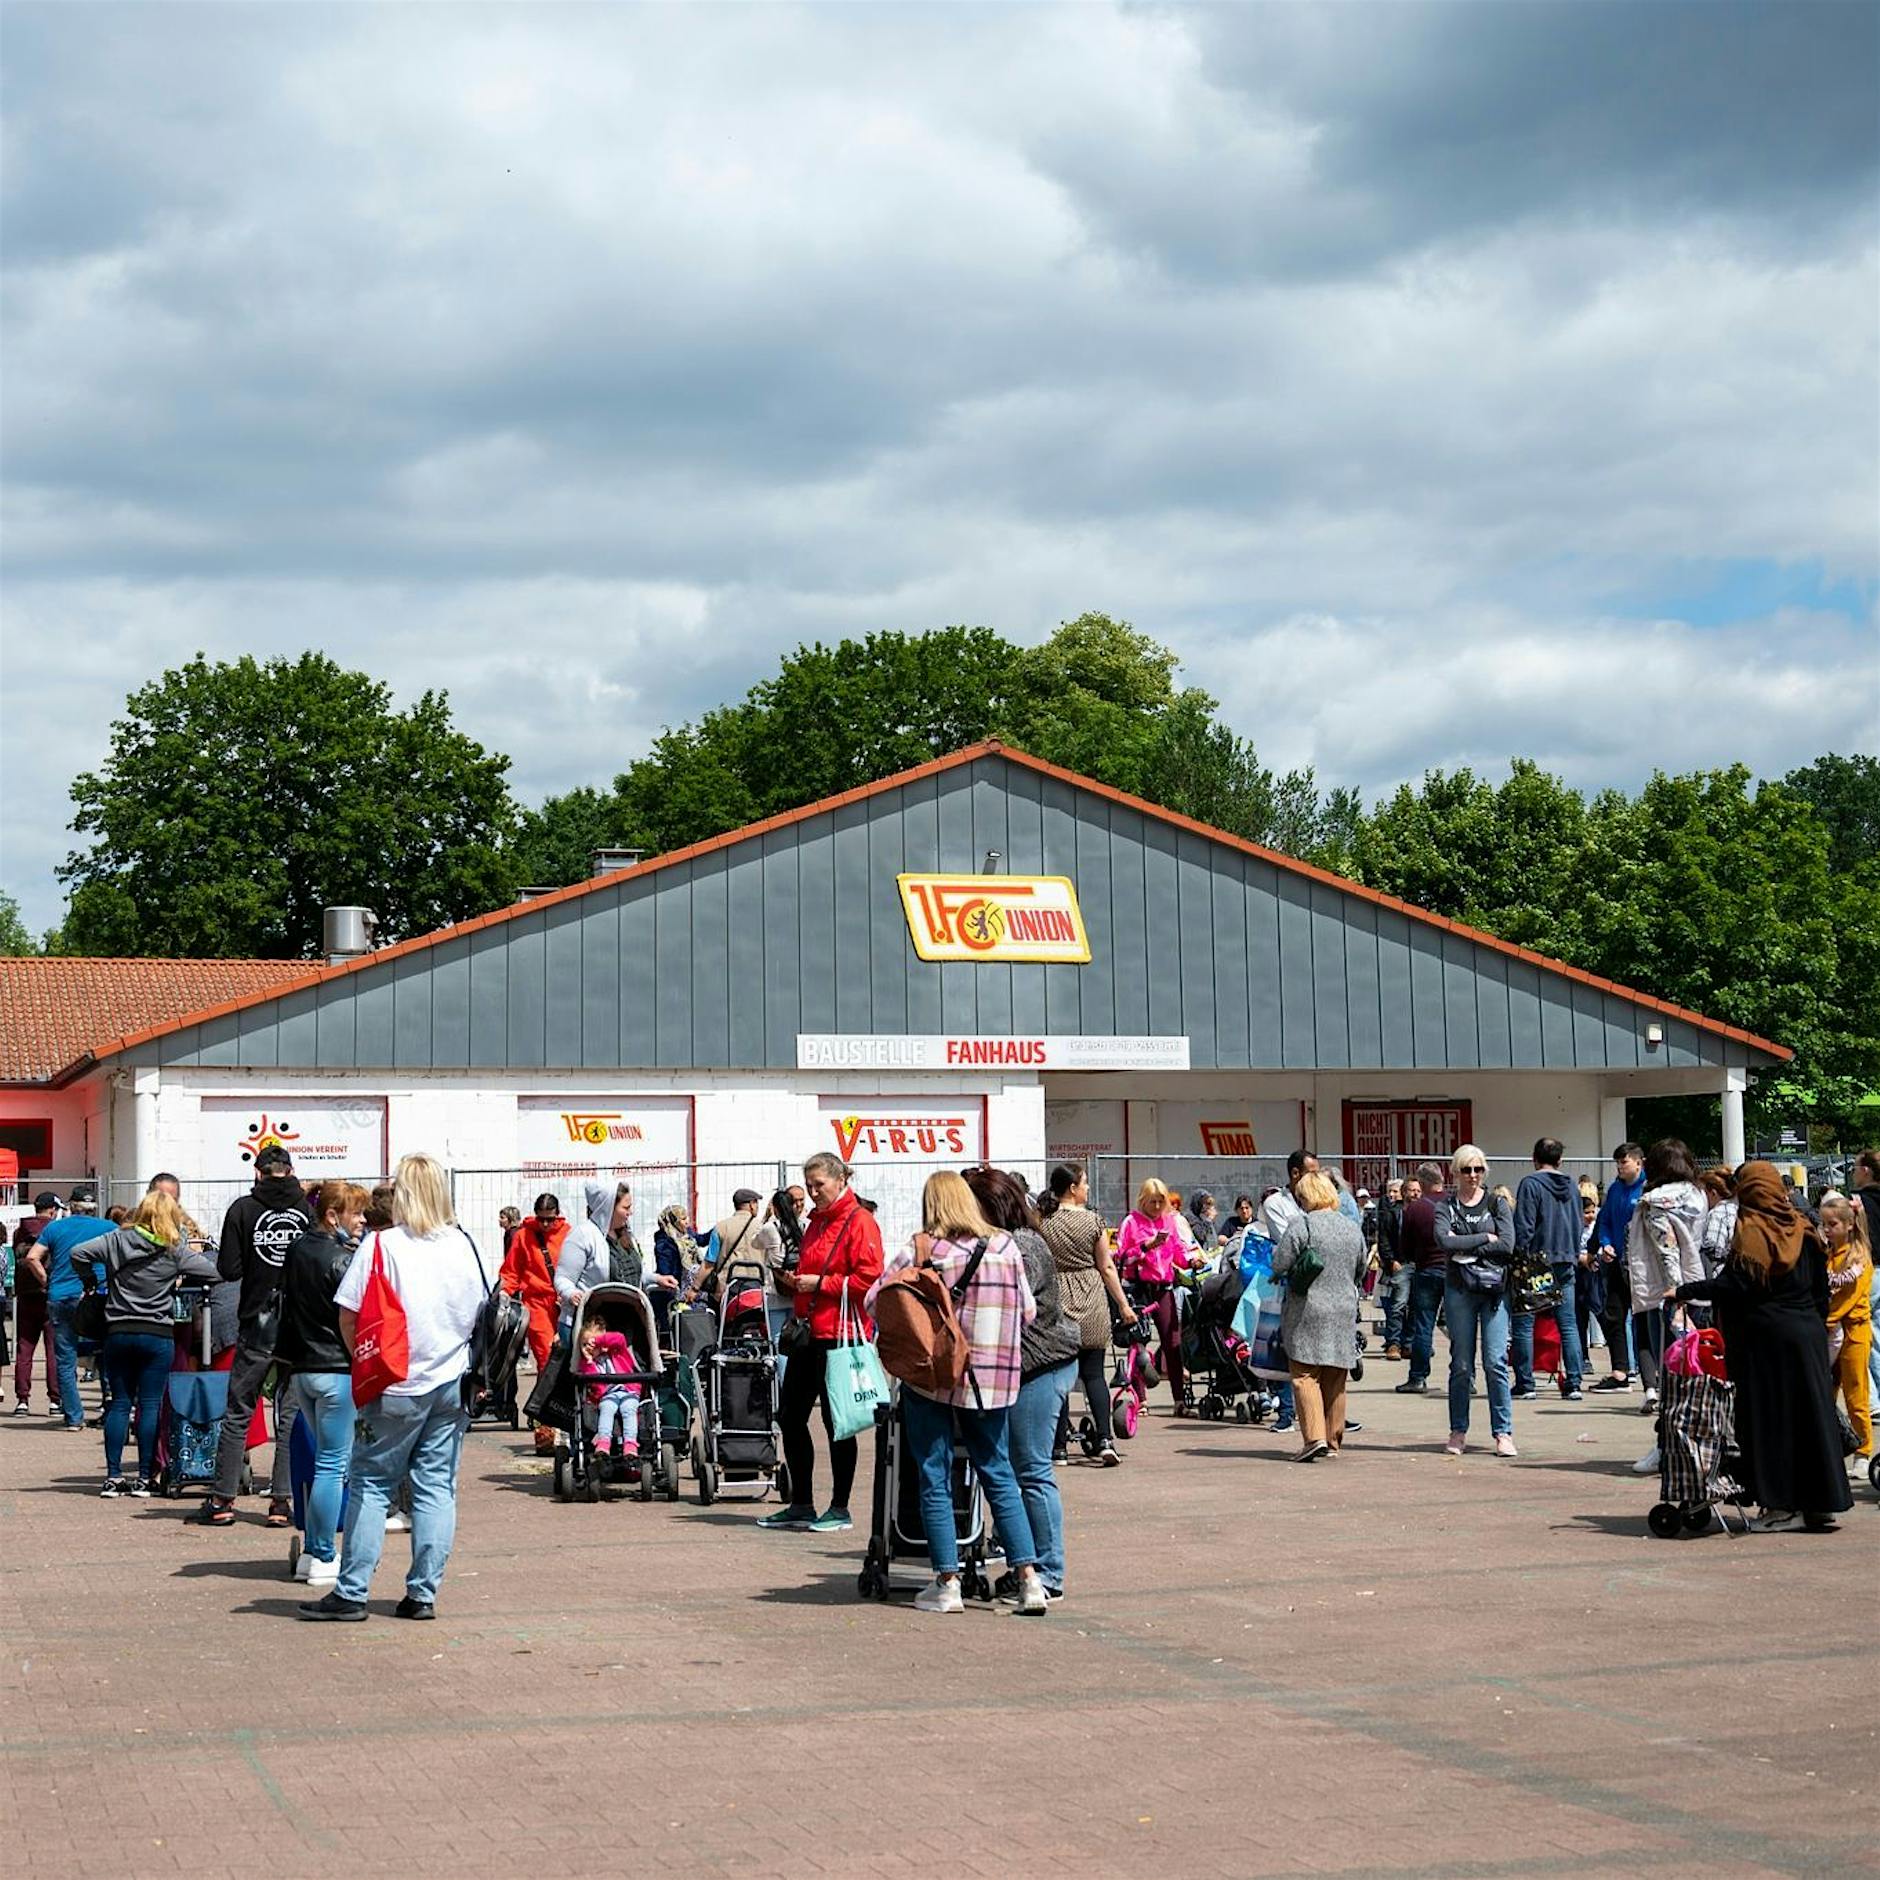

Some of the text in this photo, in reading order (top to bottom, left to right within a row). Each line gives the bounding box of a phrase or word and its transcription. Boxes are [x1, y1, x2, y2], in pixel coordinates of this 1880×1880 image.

[1005, 908, 1077, 942] UNION
[803, 1039, 925, 1065] BAUSTELLE
[946, 1040, 1047, 1065] FANHAUS
[608, 1126, 643, 1140] UNION
[1357, 1113, 1391, 1135] NICHT
[316, 1145, 348, 1153] VEREINT
[253, 1229, 305, 1246] sparc
